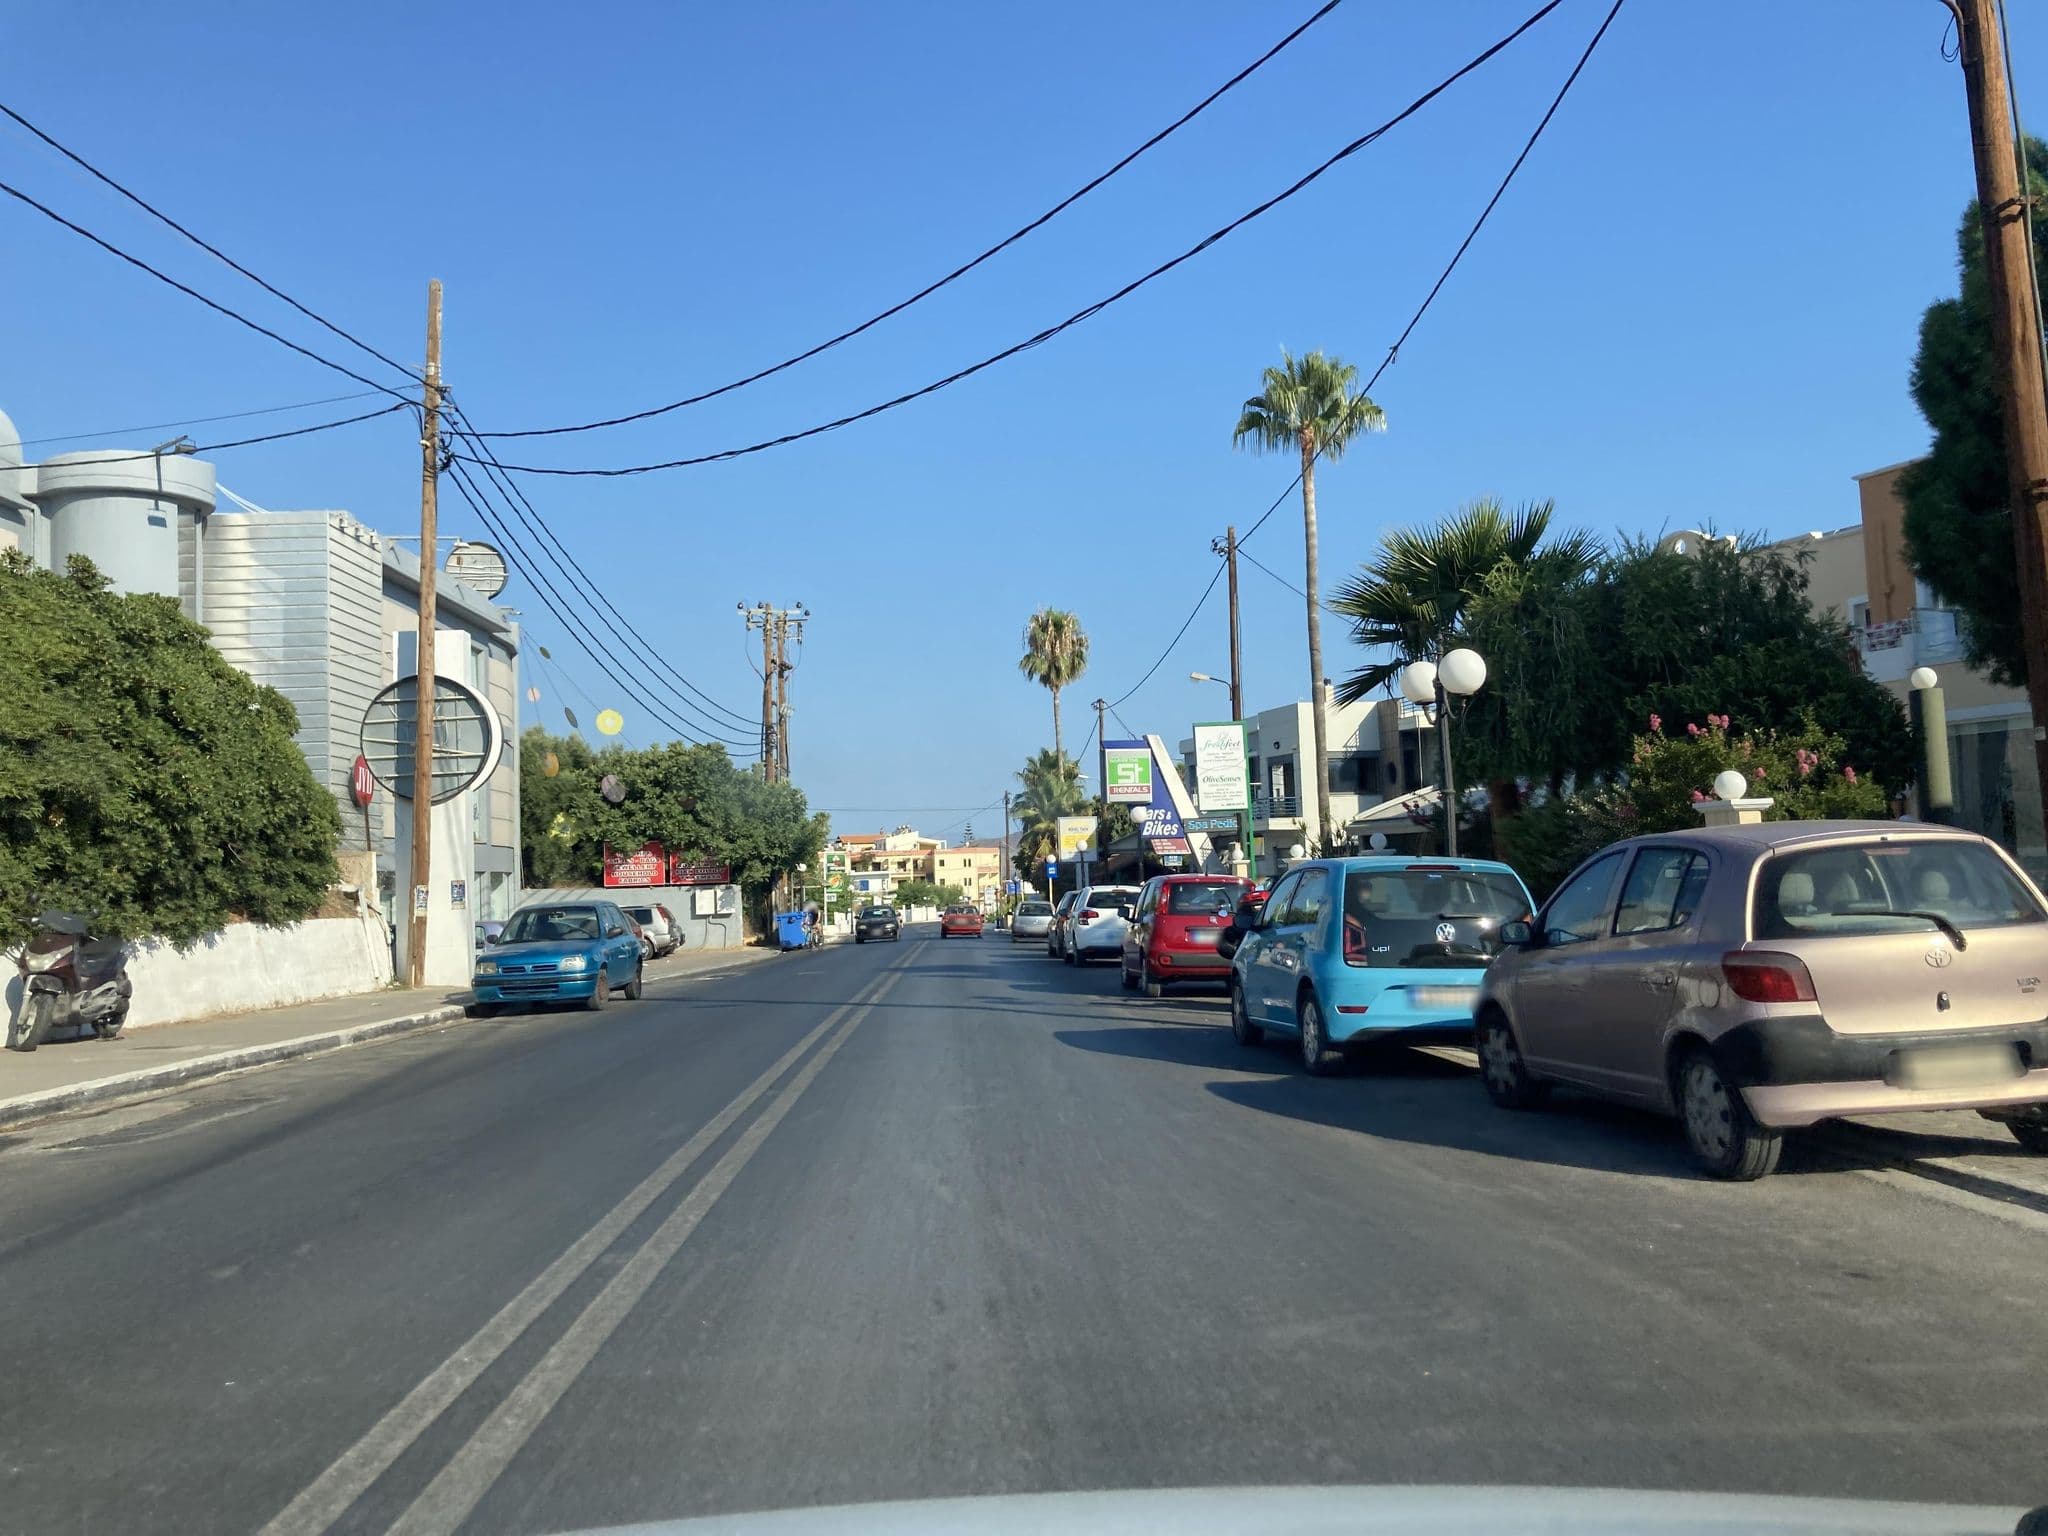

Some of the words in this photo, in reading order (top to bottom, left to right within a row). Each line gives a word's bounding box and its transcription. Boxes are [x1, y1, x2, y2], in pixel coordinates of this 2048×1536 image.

[1146, 809, 1166, 820] ars
[1166, 811, 1172, 820] &
[1142, 821, 1178, 835] Bikes
[1187, 820, 1208, 830] Spa
[1372, 945, 1390, 953] up!
